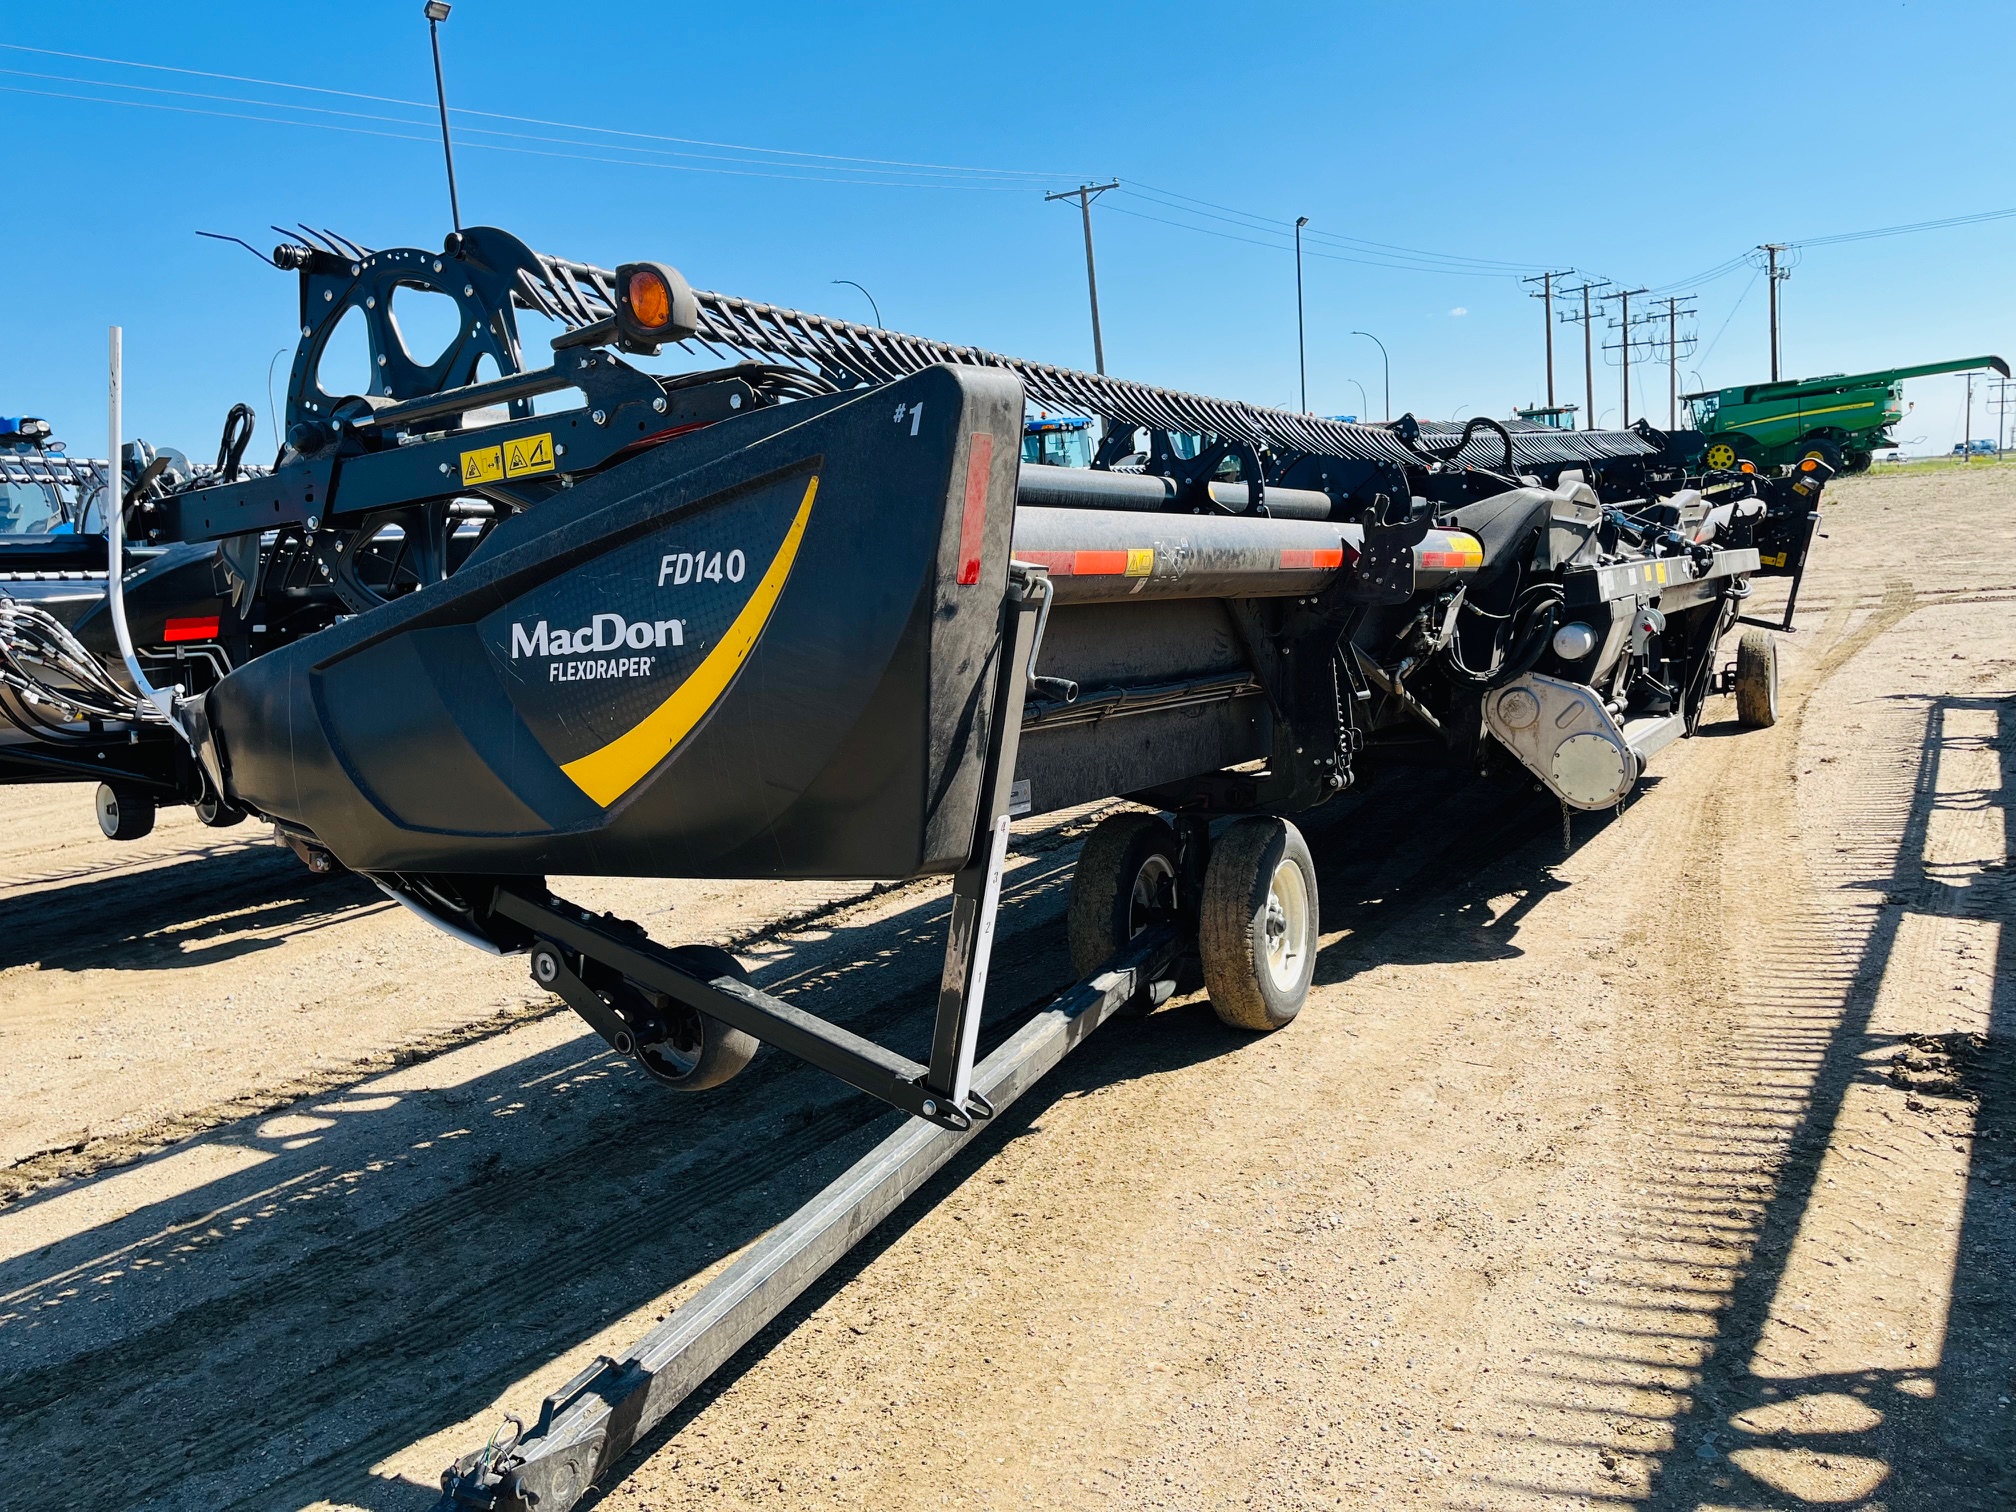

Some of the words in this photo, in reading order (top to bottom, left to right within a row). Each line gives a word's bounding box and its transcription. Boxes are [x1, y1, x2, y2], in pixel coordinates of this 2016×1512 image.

[893, 402, 924, 436] #1
[657, 549, 746, 586] FD140
[511, 613, 684, 659] MacDon
[549, 657, 651, 682] FLEXDRAPER
[985, 921, 991, 934] 2
